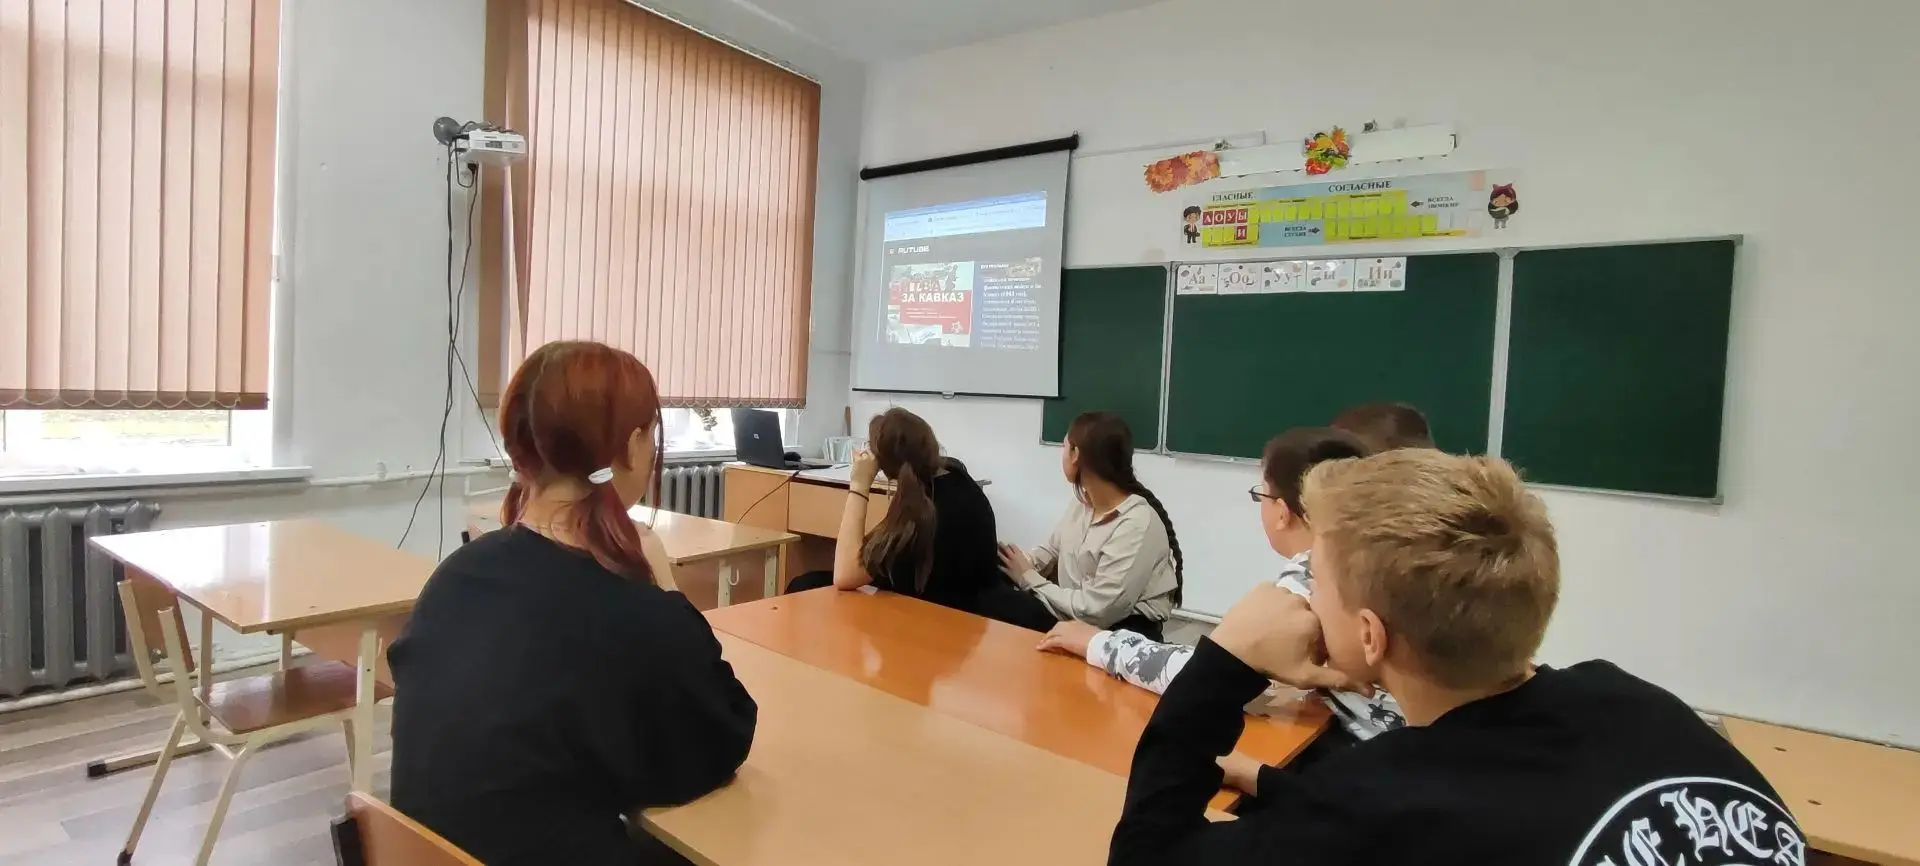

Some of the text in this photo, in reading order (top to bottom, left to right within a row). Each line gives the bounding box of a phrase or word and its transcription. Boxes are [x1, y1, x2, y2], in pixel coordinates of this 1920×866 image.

[1328, 180, 1392, 193] СОГЛАСНЫЕ
[1212, 191, 1254, 202] ГЛАСНЫЕ
[901, 291, 965, 303] ЗА КАВКАЗ
